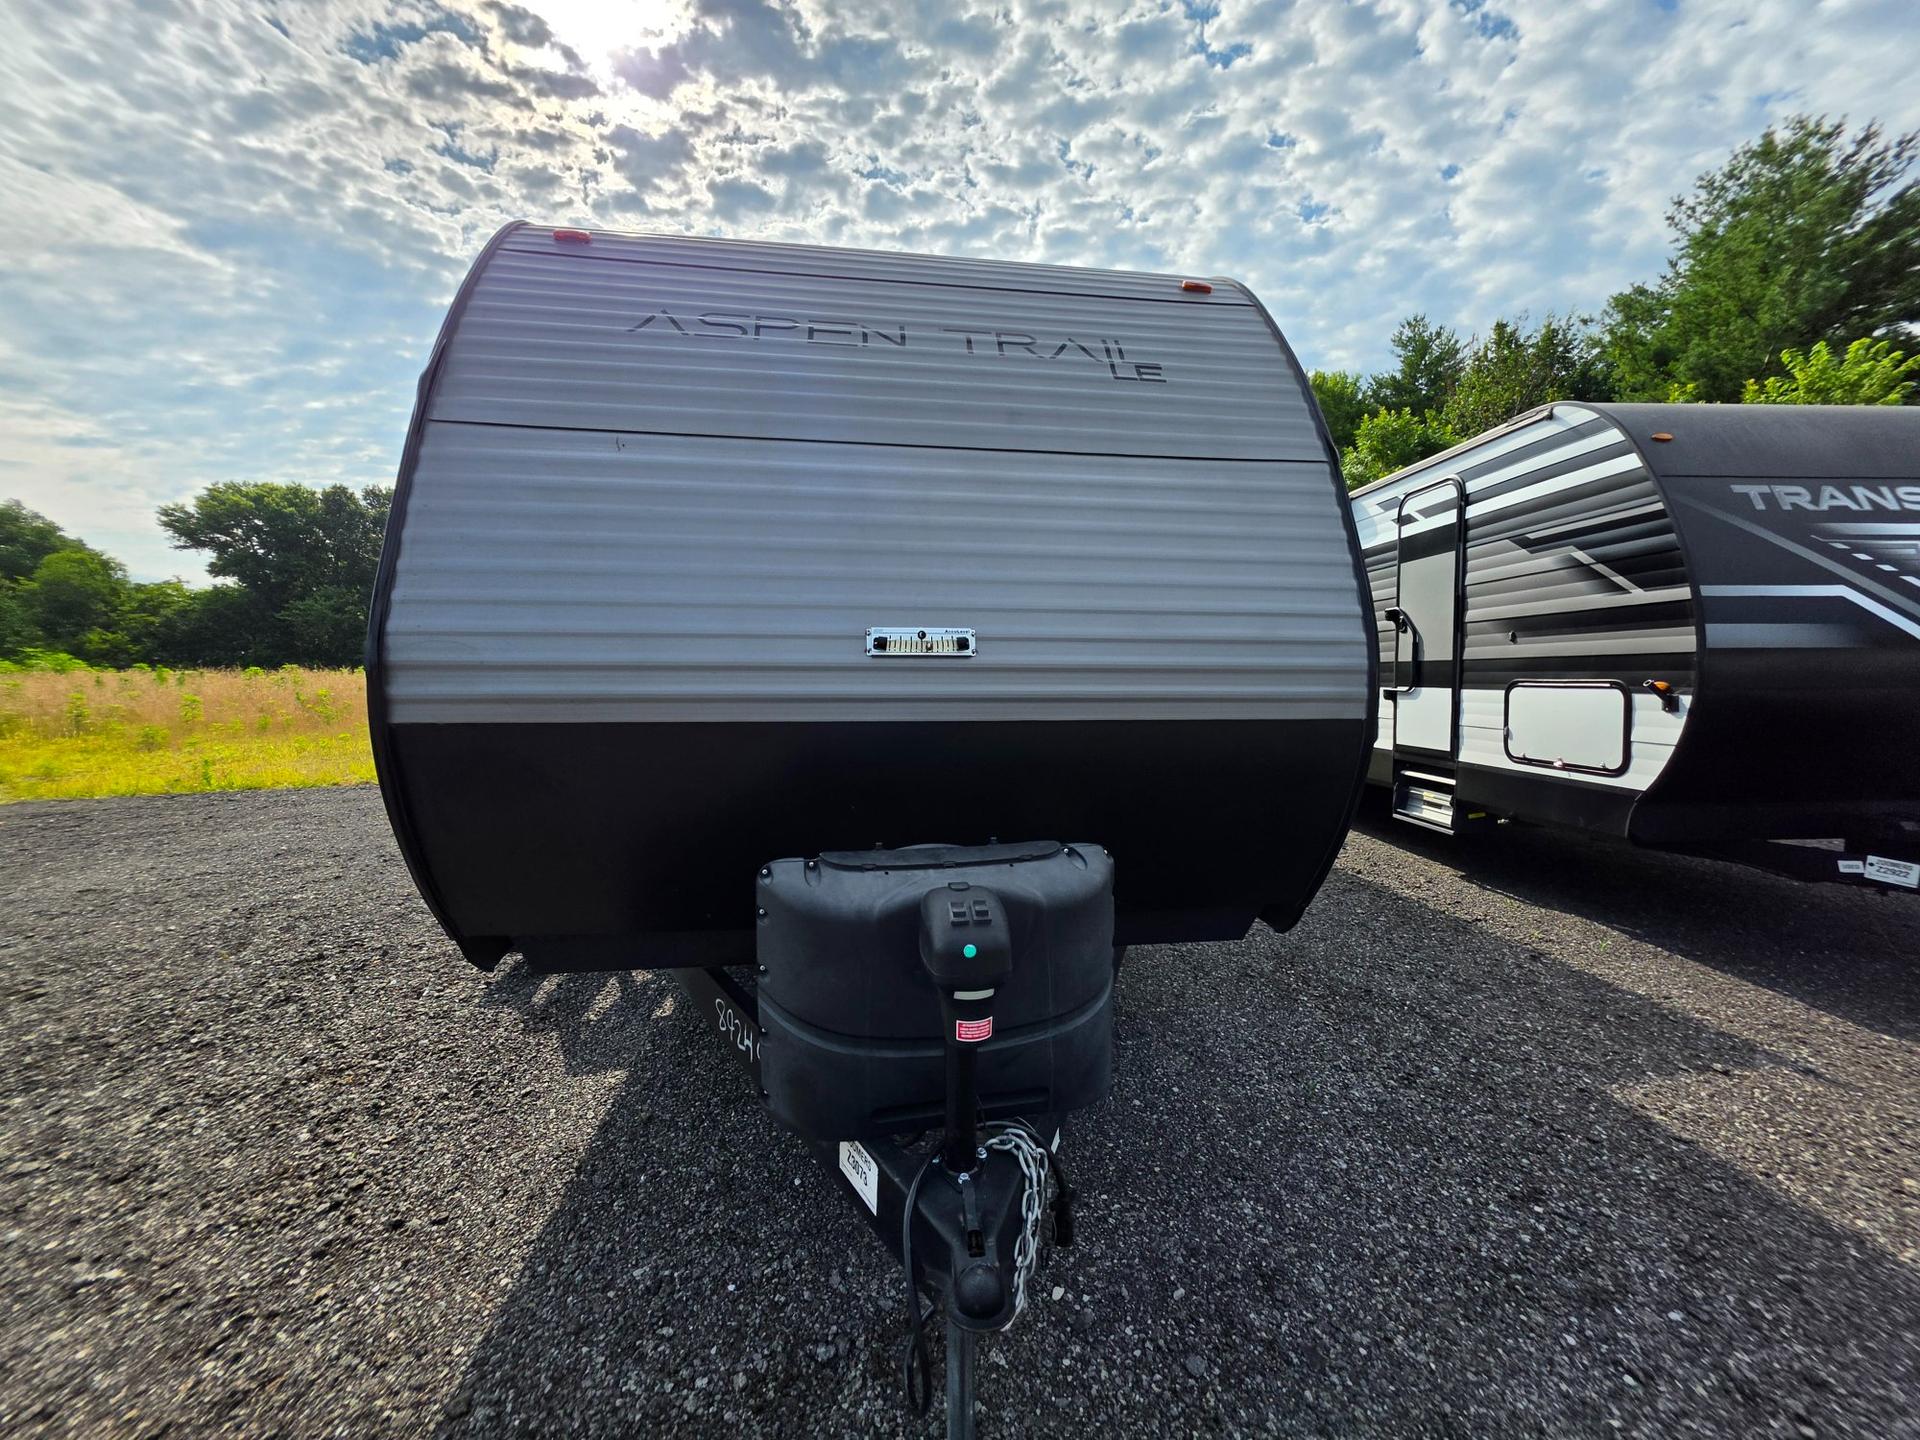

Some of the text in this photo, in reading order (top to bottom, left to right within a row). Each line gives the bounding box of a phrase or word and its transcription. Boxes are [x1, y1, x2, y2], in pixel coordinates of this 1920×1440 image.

[627, 309, 1161, 366] ASPEN TRAIL
[1109, 361, 1168, 383] LE
[1730, 484, 1920, 511] TRANS
